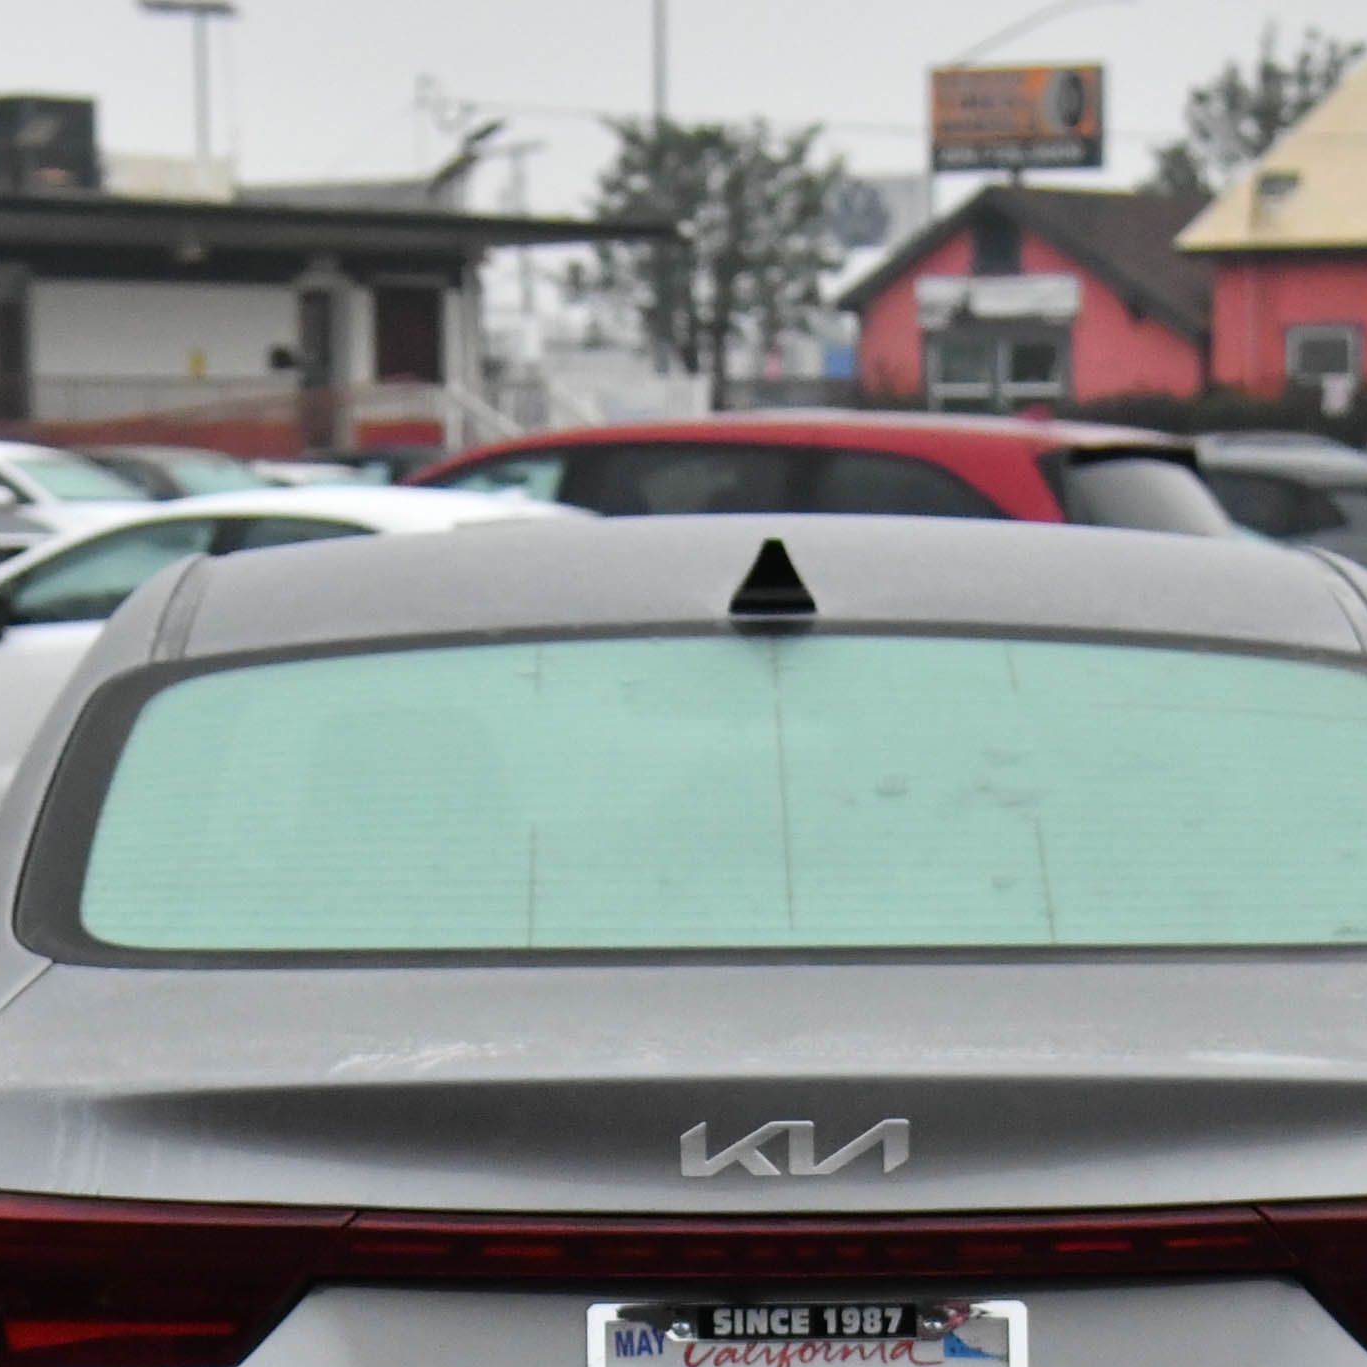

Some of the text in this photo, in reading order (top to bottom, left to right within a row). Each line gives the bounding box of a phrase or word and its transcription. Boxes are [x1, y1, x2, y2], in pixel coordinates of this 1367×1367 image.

[680, 1118, 909, 1177] KIA
[713, 1307, 904, 1335] SINCE 1987
[615, 1329, 665, 1357] MAY
